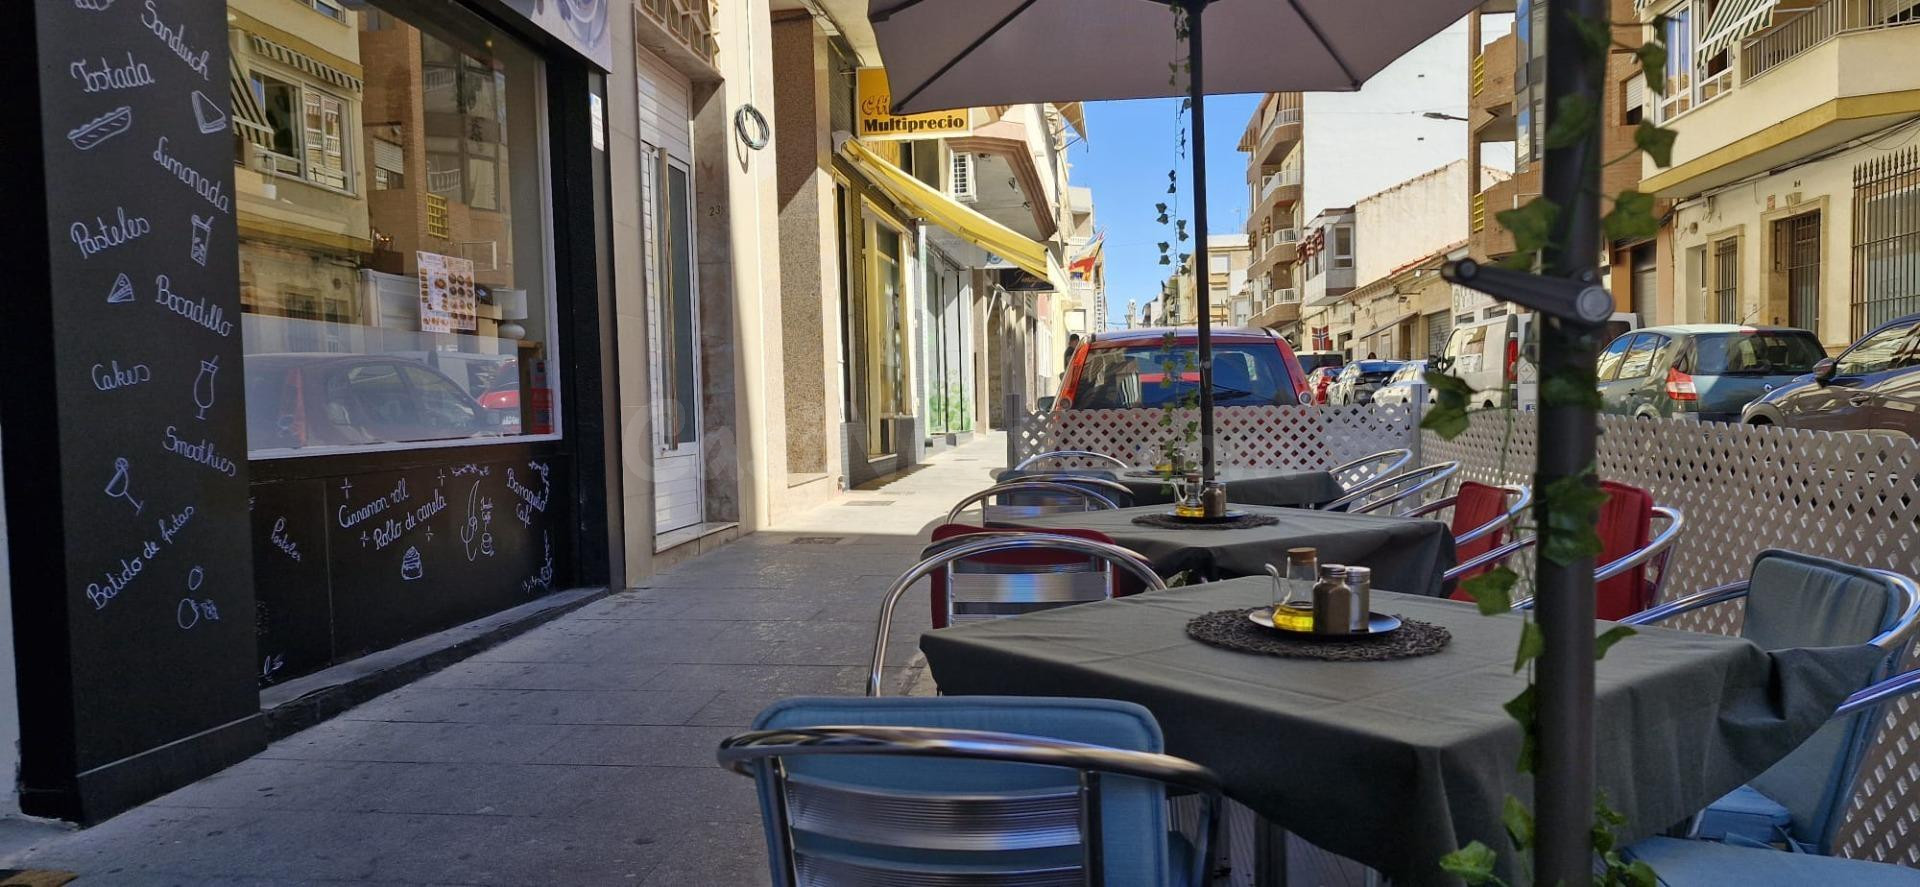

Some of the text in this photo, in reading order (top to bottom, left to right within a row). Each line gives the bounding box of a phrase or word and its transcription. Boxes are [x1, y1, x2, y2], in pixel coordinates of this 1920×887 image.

[70, 52, 155, 93] Tostada
[864, 114, 964, 133] Multiprecio
[153, 136, 229, 213] Limonada
[70, 206, 150, 259] Pasteles
[155, 275, 234, 336] Bocadillo
[92, 360, 150, 391] Cakes
[162, 425, 237, 477] Smoothies
[373, 518, 402, 550] Rollo
[405, 512, 417, 530] de
[417, 488, 447, 521] canela
[86, 506, 194, 610] Batido de frutas
